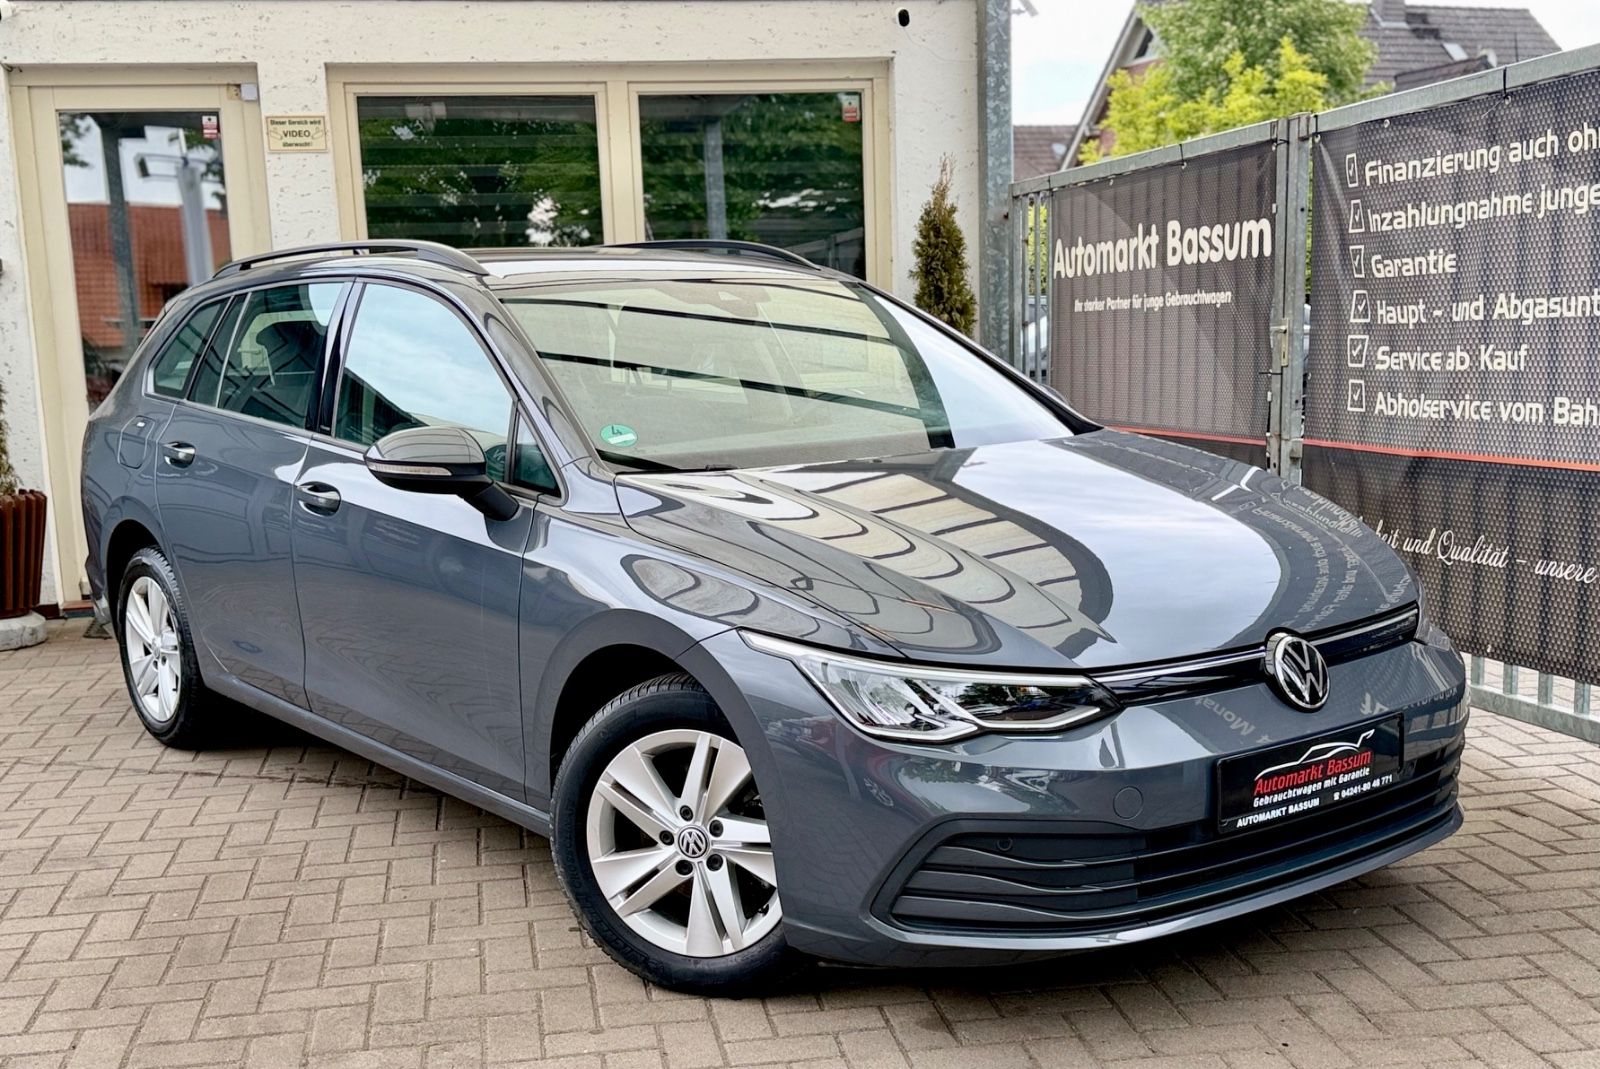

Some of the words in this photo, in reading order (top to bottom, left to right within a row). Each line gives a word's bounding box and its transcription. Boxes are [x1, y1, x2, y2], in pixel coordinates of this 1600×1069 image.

[282, 129, 311, 138] VIDEO
[1365, 145, 1501, 186] Finanzierung
[1508, 129, 1559, 163] auch
[1567, 122, 1600, 153] oh
[1367, 191, 1533, 232] Inzahlungnahme
[1537, 183, 1600, 219] junge
[1054, 223, 1159, 279] Automarkt
[1167, 218, 1272, 266] Bassum
[1371, 248, 1457, 278] Garantie
[1106, 296, 1131, 310] Partner
[1132, 293, 1143, 309] für
[1143, 293, 1164, 312] junge
[1165, 289, 1232, 308] Gebrauchtwagen
[1377, 300, 1427, 329] Haupt
[1452, 294, 1484, 322] und
[1492, 288, 1600, 325] Abgasunt
[1374, 345, 1442, 371] Service
[1445, 345, 1470, 371] ab
[1480, 344, 1528, 371] Kauf
[1374, 391, 1491, 421] Abholservice
[1499, 402, 1544, 424] vom
[1553, 396, 1600, 426] Bah
[1402, 527, 1434, 555] und
[1437, 530, 1509, 565] Qualität
[1534, 558, 1598, 584] unsere
[1253, 764, 1324, 796] Automarkt
[1326, 750, 1372, 776] Bassum
[1253, 781, 1322, 807] Gebrauchtwagen
[1323, 777, 1338, 789] mit
[1338, 766, 1370, 784] Garantie
[1236, 806, 1287, 828] AUTOMARKT
[1288, 797, 1320, 814] BASSUM
